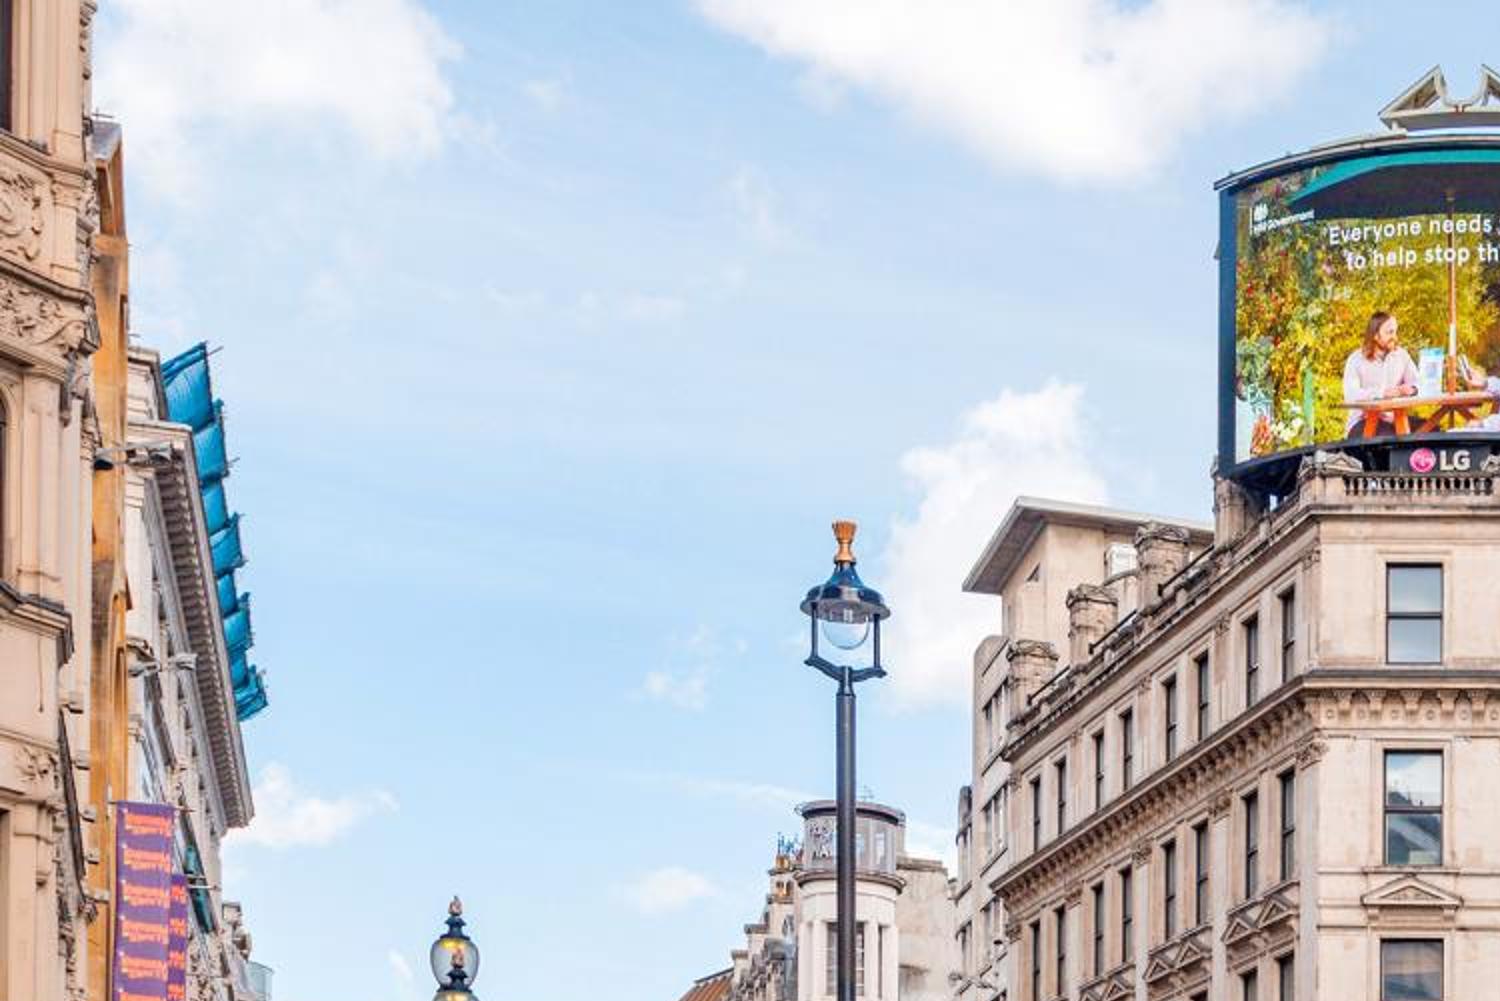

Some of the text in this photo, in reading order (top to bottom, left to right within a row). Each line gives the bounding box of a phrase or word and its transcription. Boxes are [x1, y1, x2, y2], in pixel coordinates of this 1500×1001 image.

[1329, 220, 1422, 246] Everyone
[1429, 214, 1492, 234] needs
[1346, 251, 1366, 270] to
[1371, 247, 1417, 269] help
[1424, 244, 1470, 266] stop
[1440, 449, 1471, 471] LG
